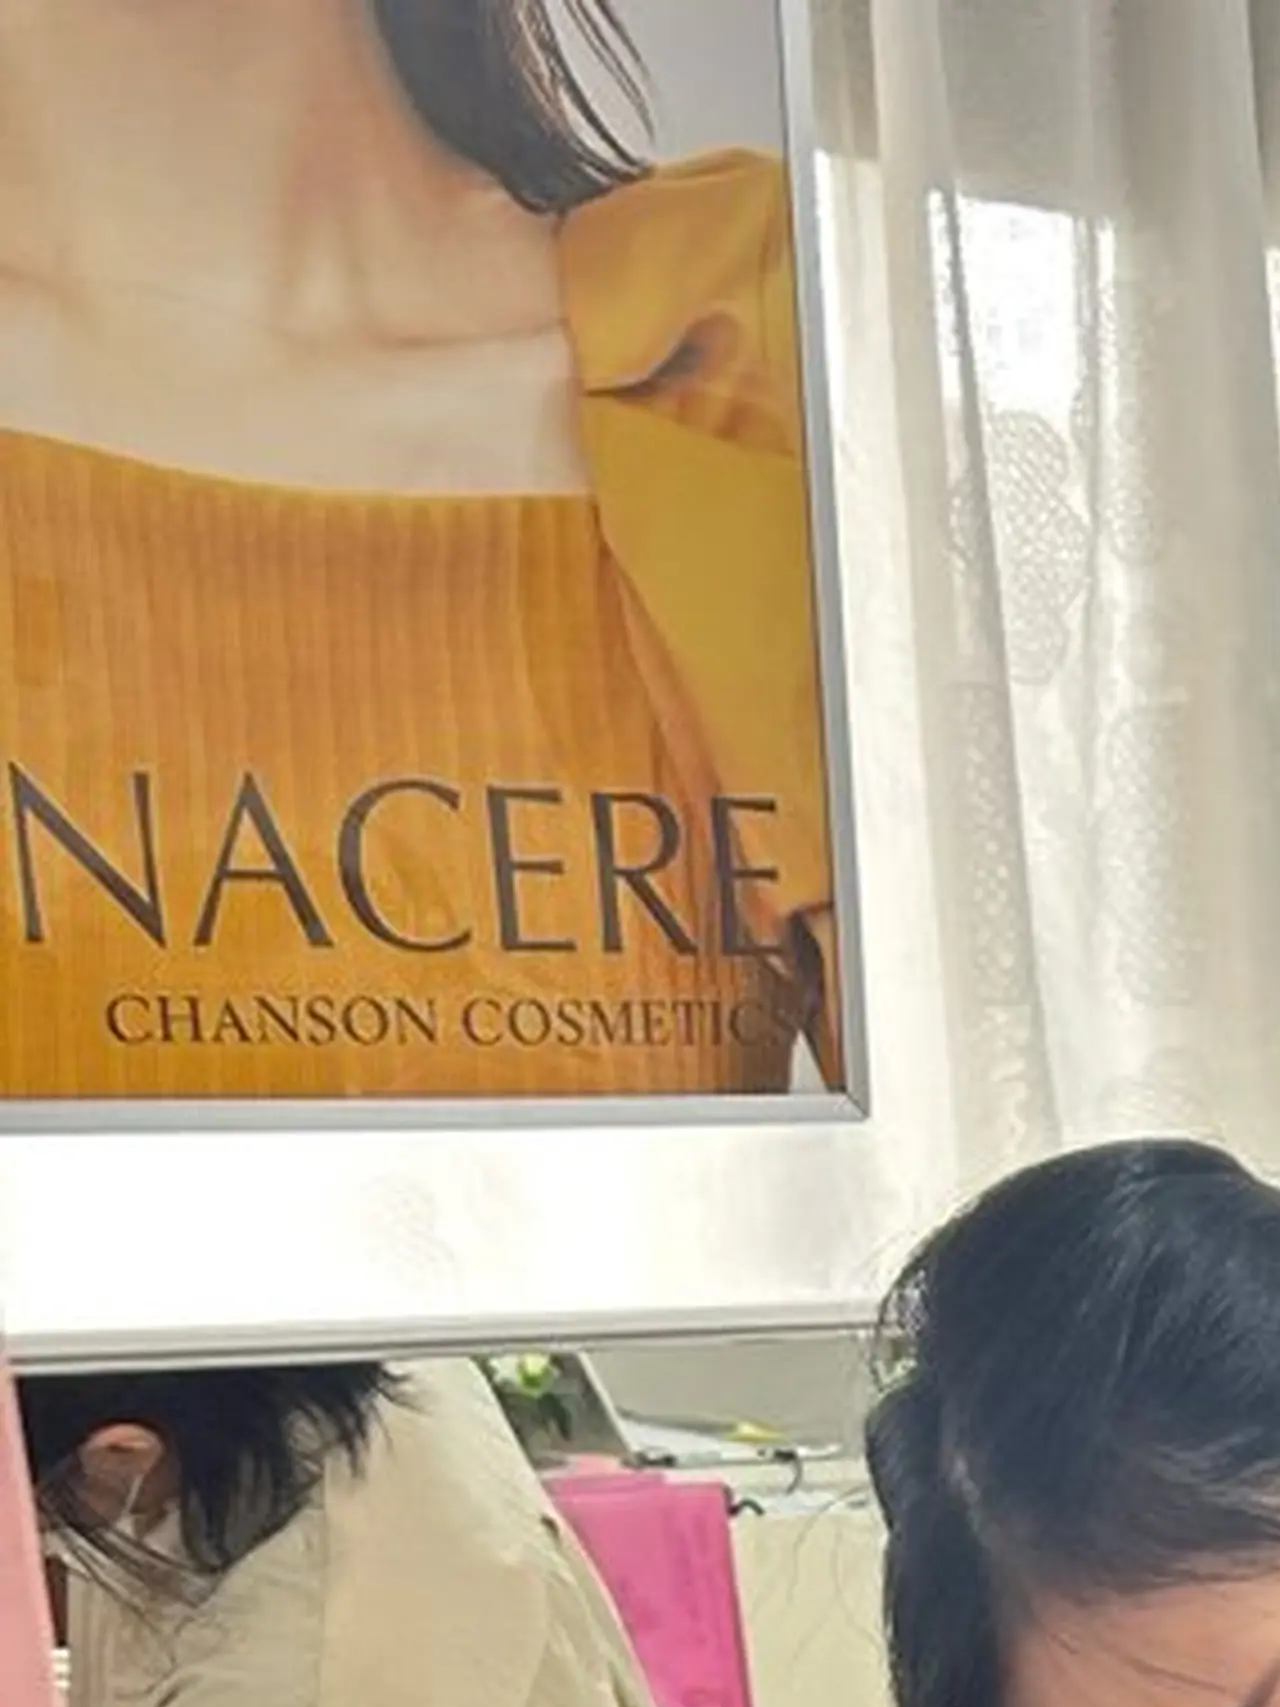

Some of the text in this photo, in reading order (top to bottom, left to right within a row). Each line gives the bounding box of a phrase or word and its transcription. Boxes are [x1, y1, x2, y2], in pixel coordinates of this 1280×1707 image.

[8, 761, 787, 956] NACERE
[106, 994, 797, 1047] CHANSON COSMETICS
